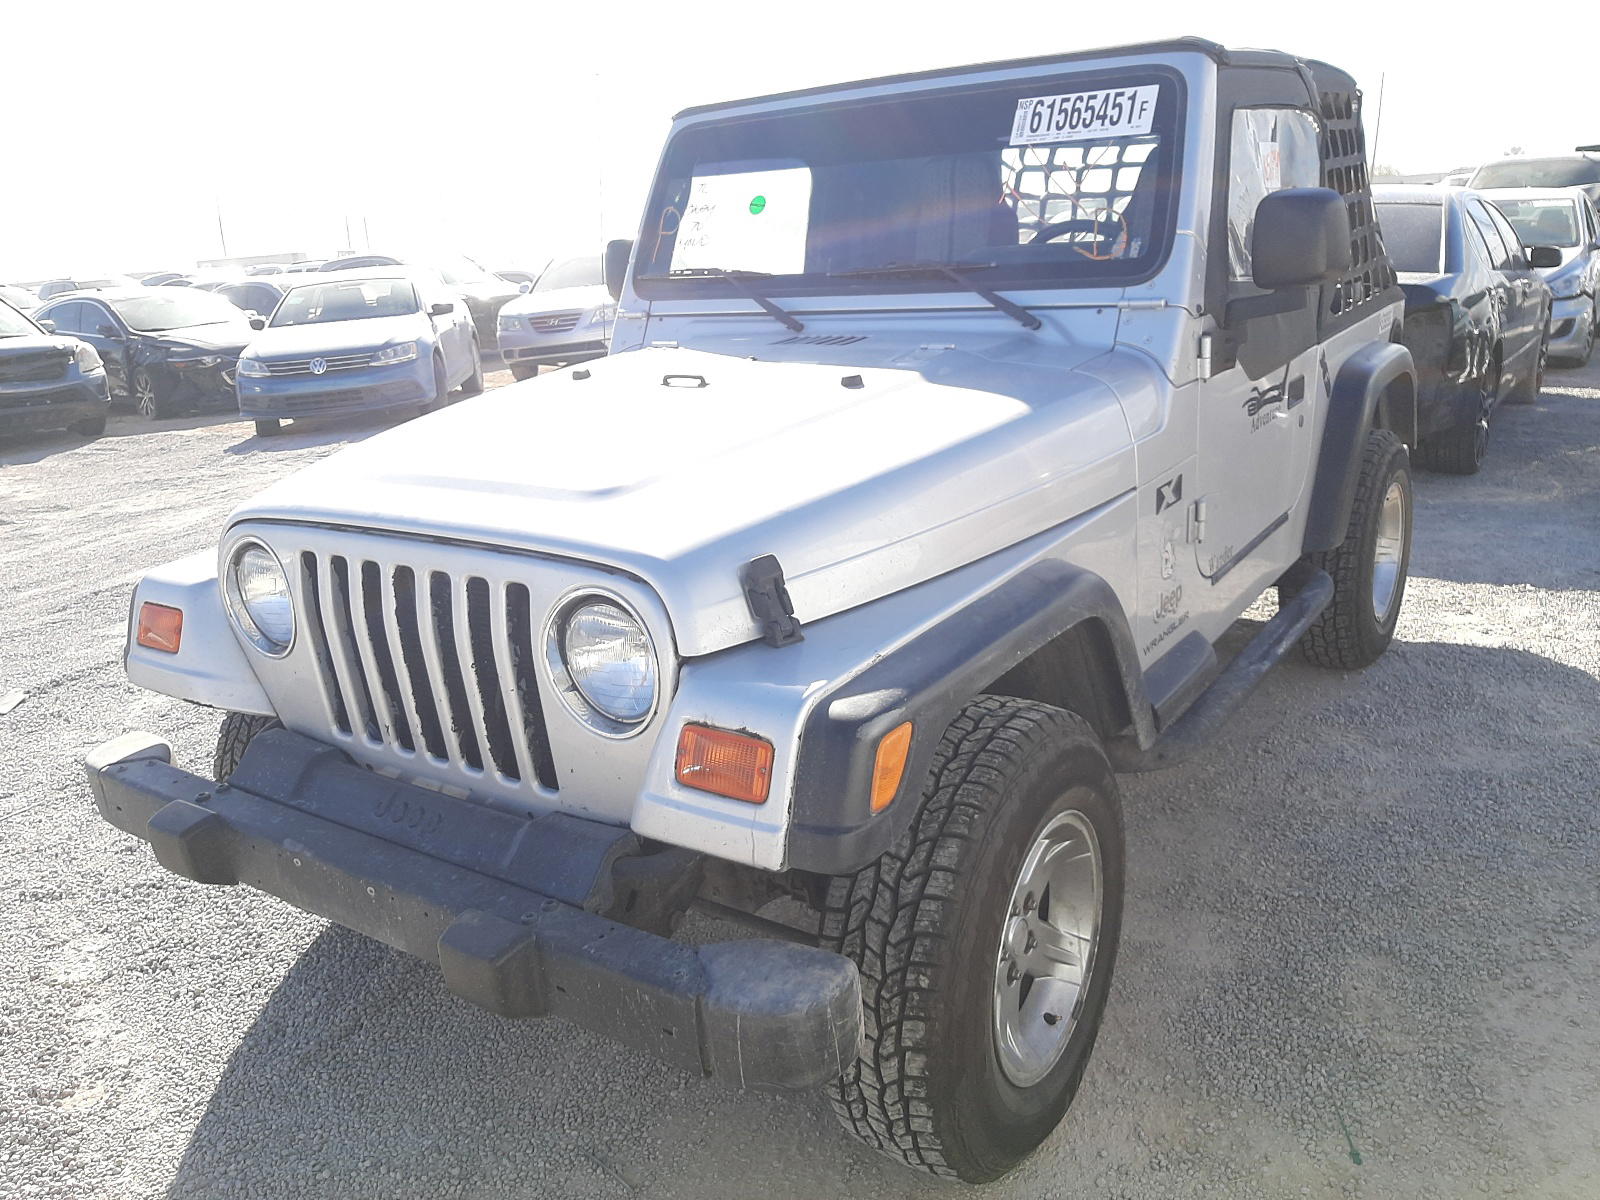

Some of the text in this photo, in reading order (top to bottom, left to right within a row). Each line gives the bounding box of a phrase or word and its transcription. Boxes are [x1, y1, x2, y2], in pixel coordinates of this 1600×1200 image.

[1018, 100, 1034, 111] NSP
[1029, 91, 1138, 134] 61565451
[1138, 100, 1149, 120] F
[1154, 585, 1183, 621] Jeep
